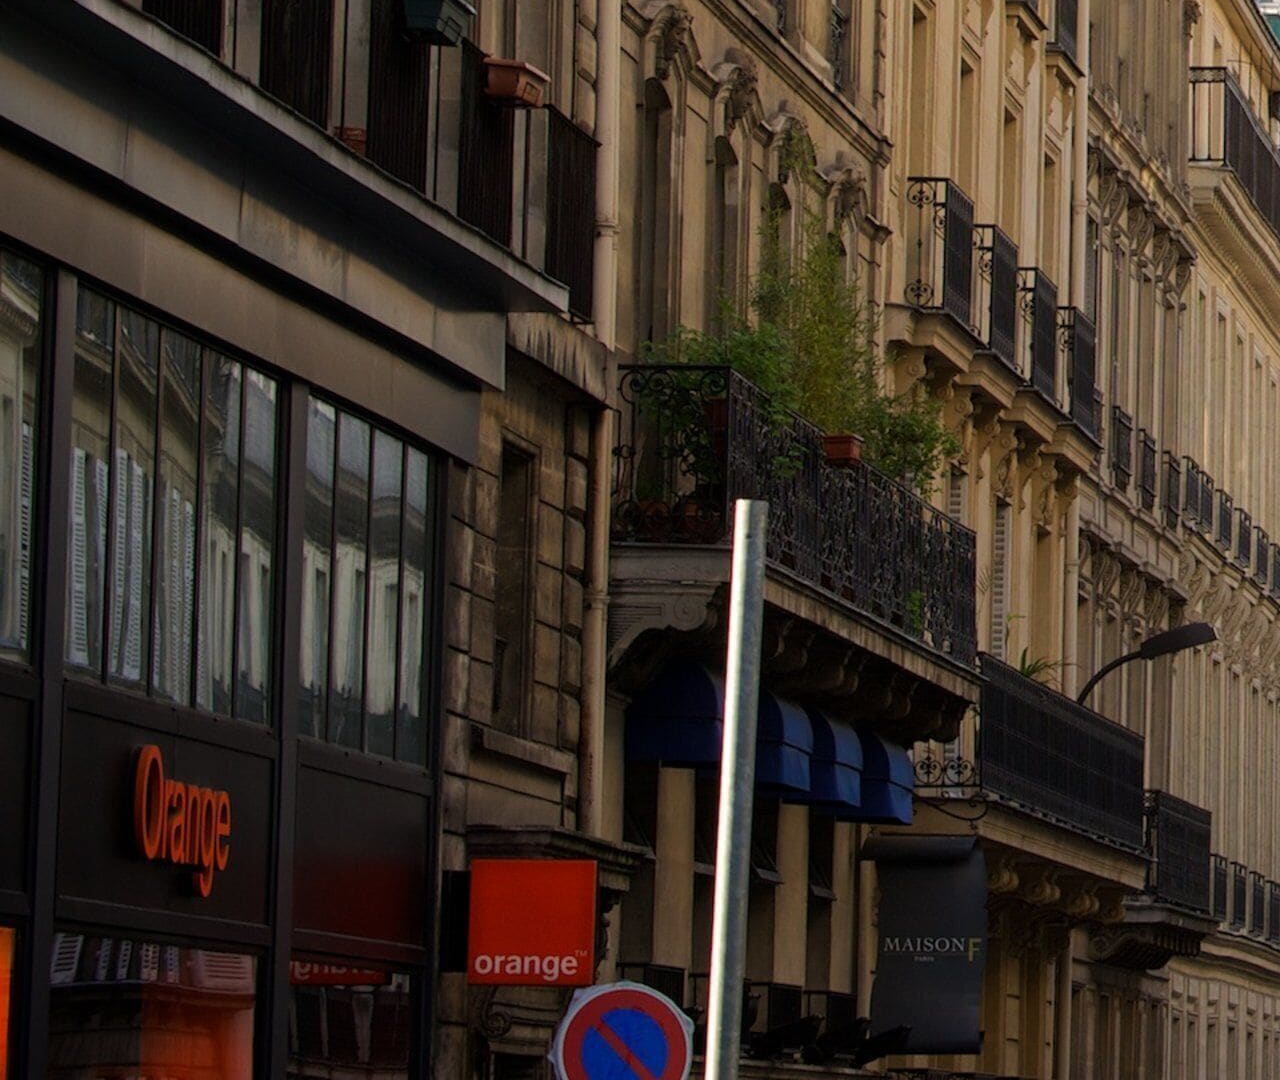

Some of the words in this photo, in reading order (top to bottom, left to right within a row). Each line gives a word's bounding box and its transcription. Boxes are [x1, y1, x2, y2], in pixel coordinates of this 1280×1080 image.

[135, 744, 231, 898] Orange
[883, 937, 965, 952] MAISON
[968, 938, 982, 962] F
[474, 955, 578, 981] orange
